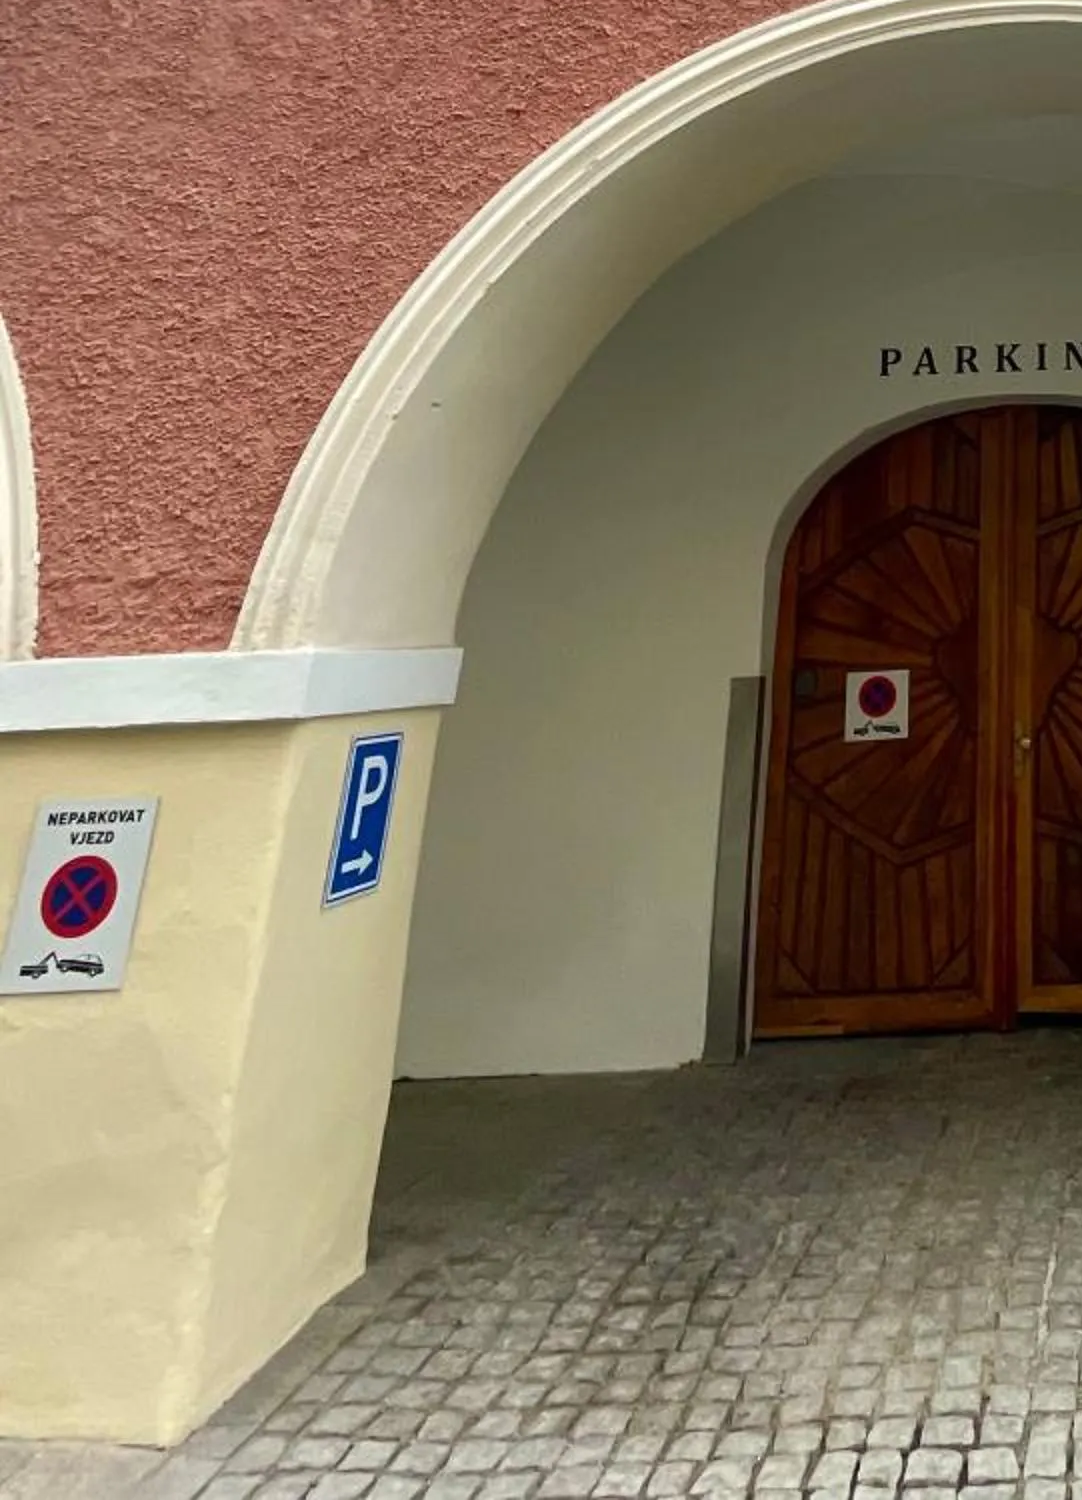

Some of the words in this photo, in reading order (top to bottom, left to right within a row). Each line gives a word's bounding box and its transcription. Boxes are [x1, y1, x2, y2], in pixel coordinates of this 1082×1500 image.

[350, 754, 388, 841] P
[47, 808, 146, 826] NEPARKOVAT
[69, 830, 114, 845] VJEZD
